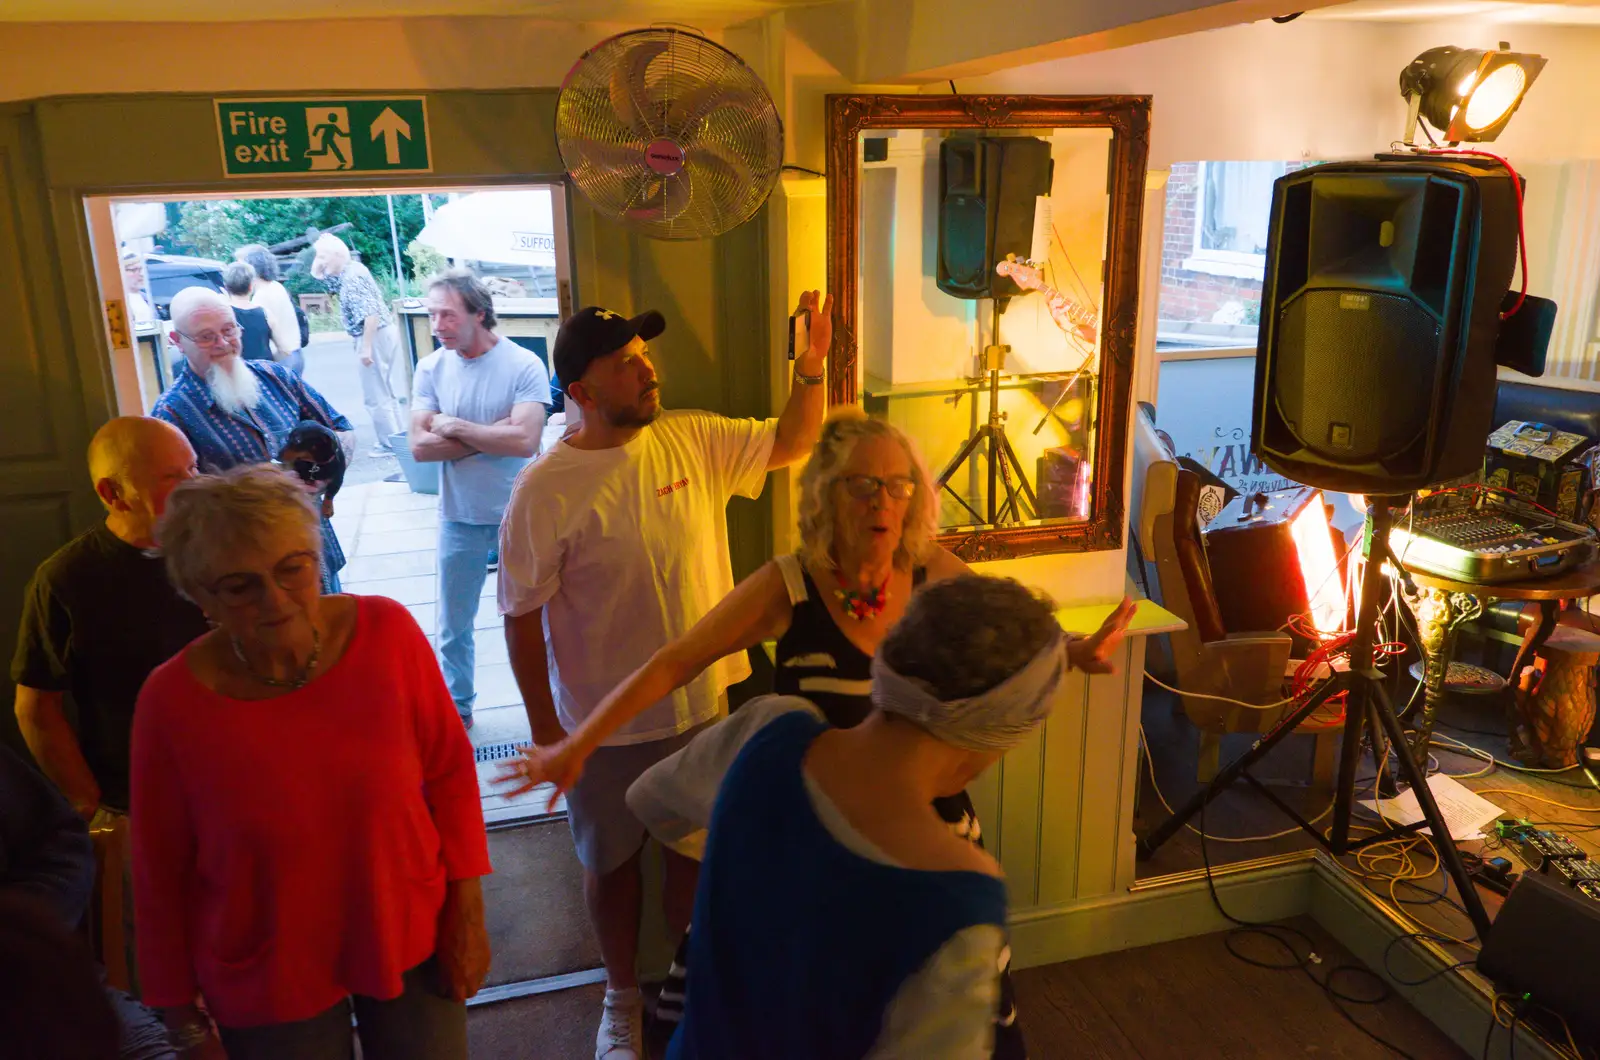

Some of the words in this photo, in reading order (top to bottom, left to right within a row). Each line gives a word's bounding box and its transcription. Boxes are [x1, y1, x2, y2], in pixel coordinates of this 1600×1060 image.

[229, 111, 287, 135] Fire
[235, 139, 290, 163] exit
[521, 236, 555, 250] SUFFOL
[656, 485, 673, 497] ZACH
